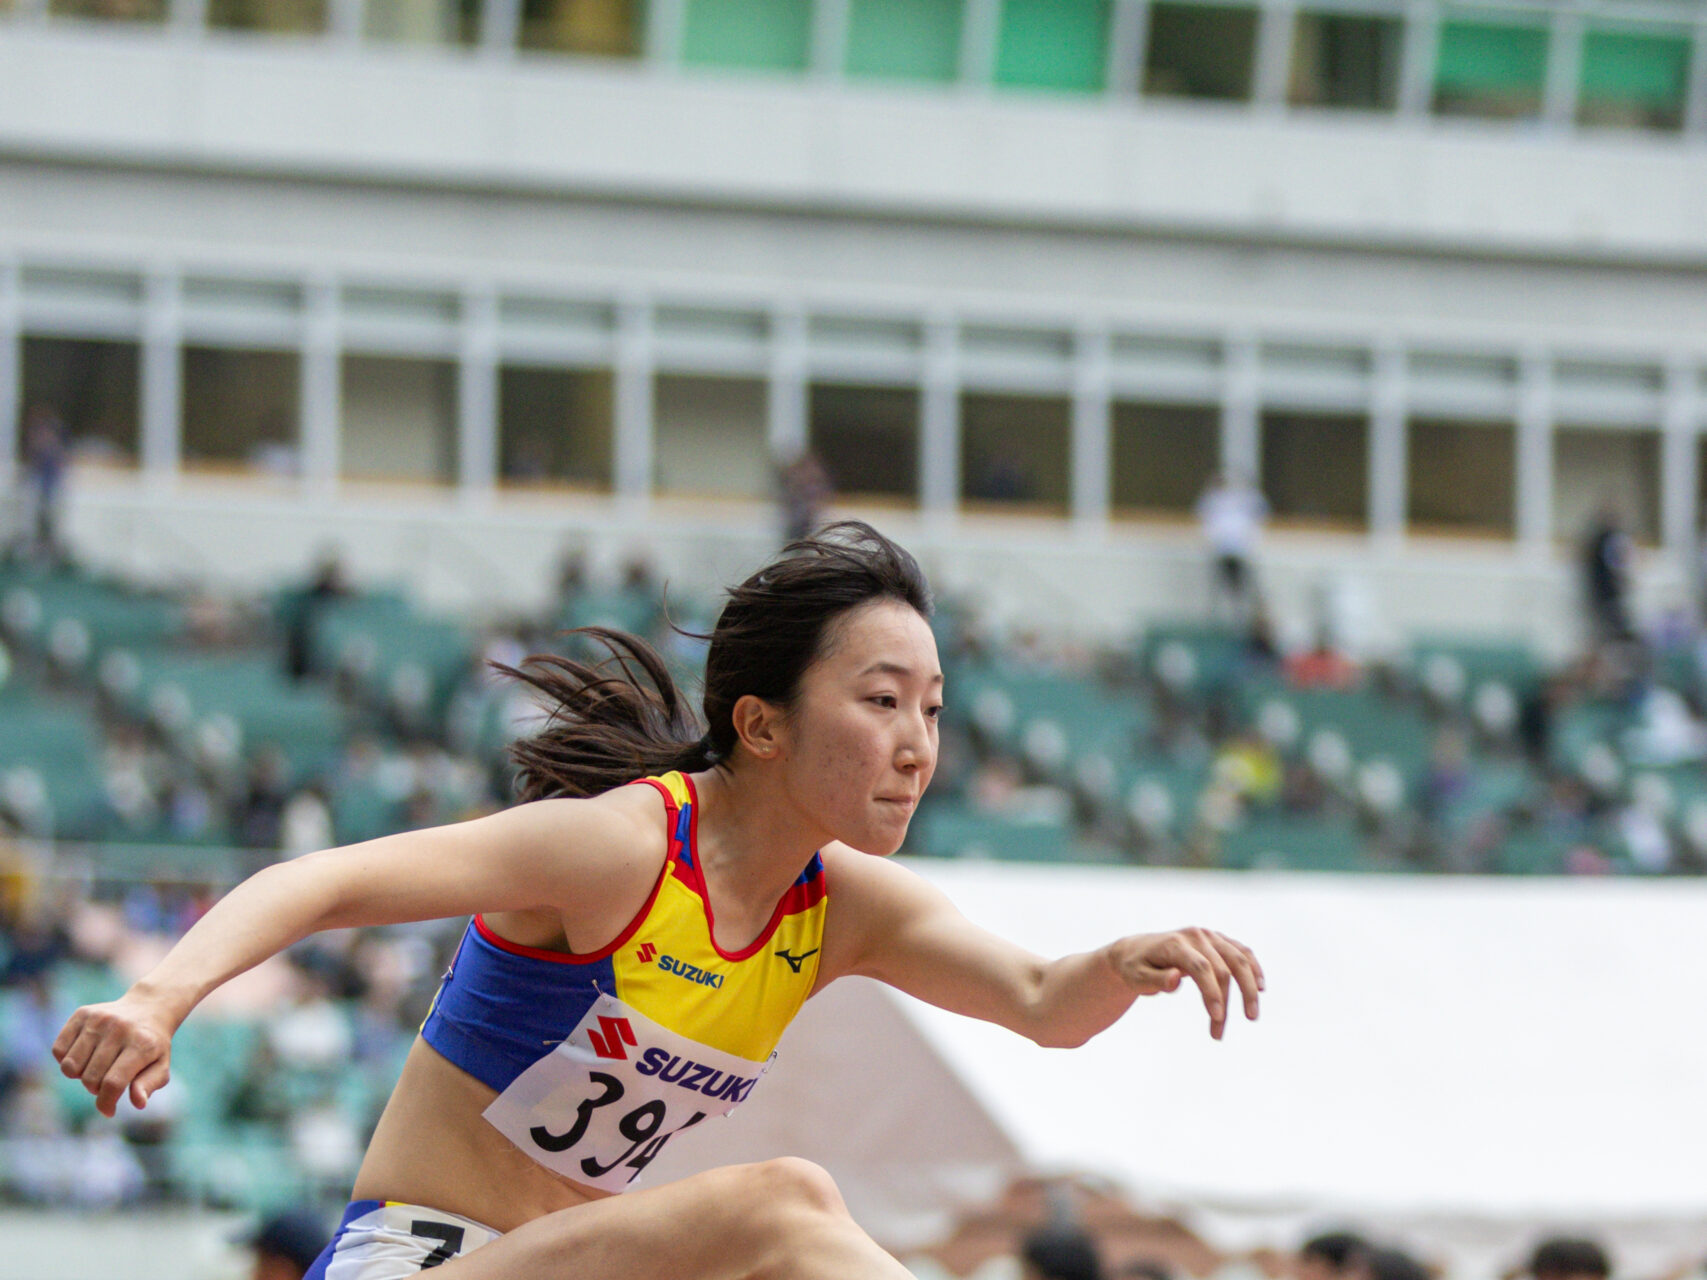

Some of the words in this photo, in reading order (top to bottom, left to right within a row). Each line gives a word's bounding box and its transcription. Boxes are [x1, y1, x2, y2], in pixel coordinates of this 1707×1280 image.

[658, 955, 724, 989] SUZUKI
[635, 1047, 758, 1103] SUZUKI
[411, 1219, 465, 1271] 7
